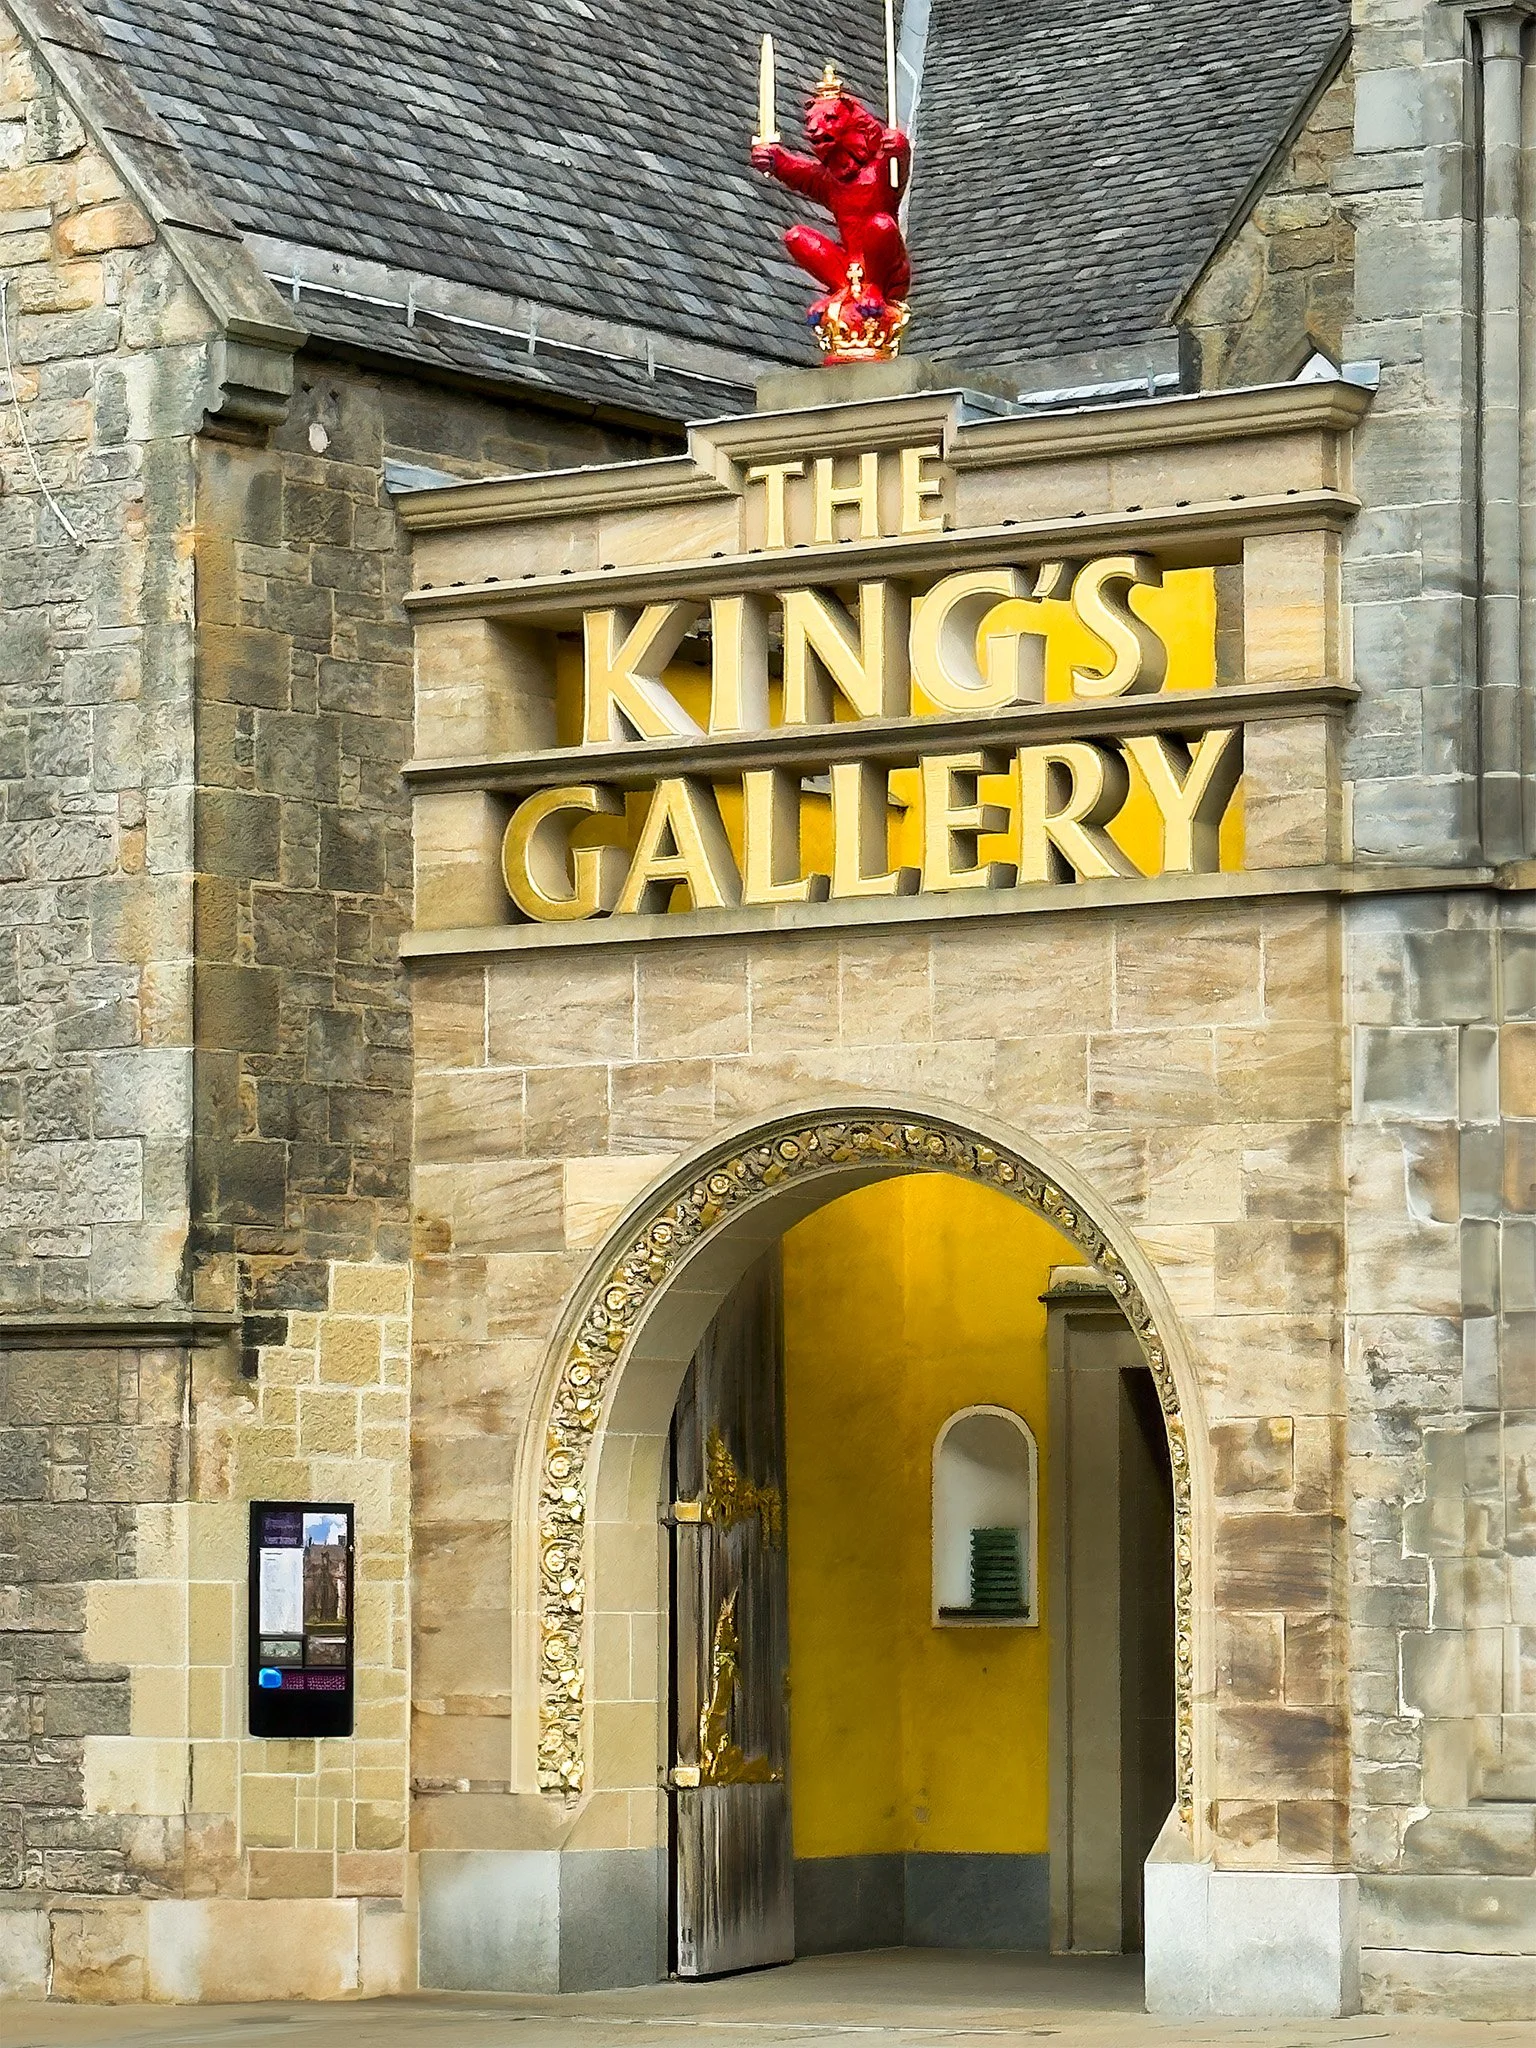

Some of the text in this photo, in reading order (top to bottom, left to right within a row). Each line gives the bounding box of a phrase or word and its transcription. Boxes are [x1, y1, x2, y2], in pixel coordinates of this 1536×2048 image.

[747, 445, 945, 549] THE
[582, 554, 1160, 745] KING'S
[502, 728, 1242, 922] GALLERY
